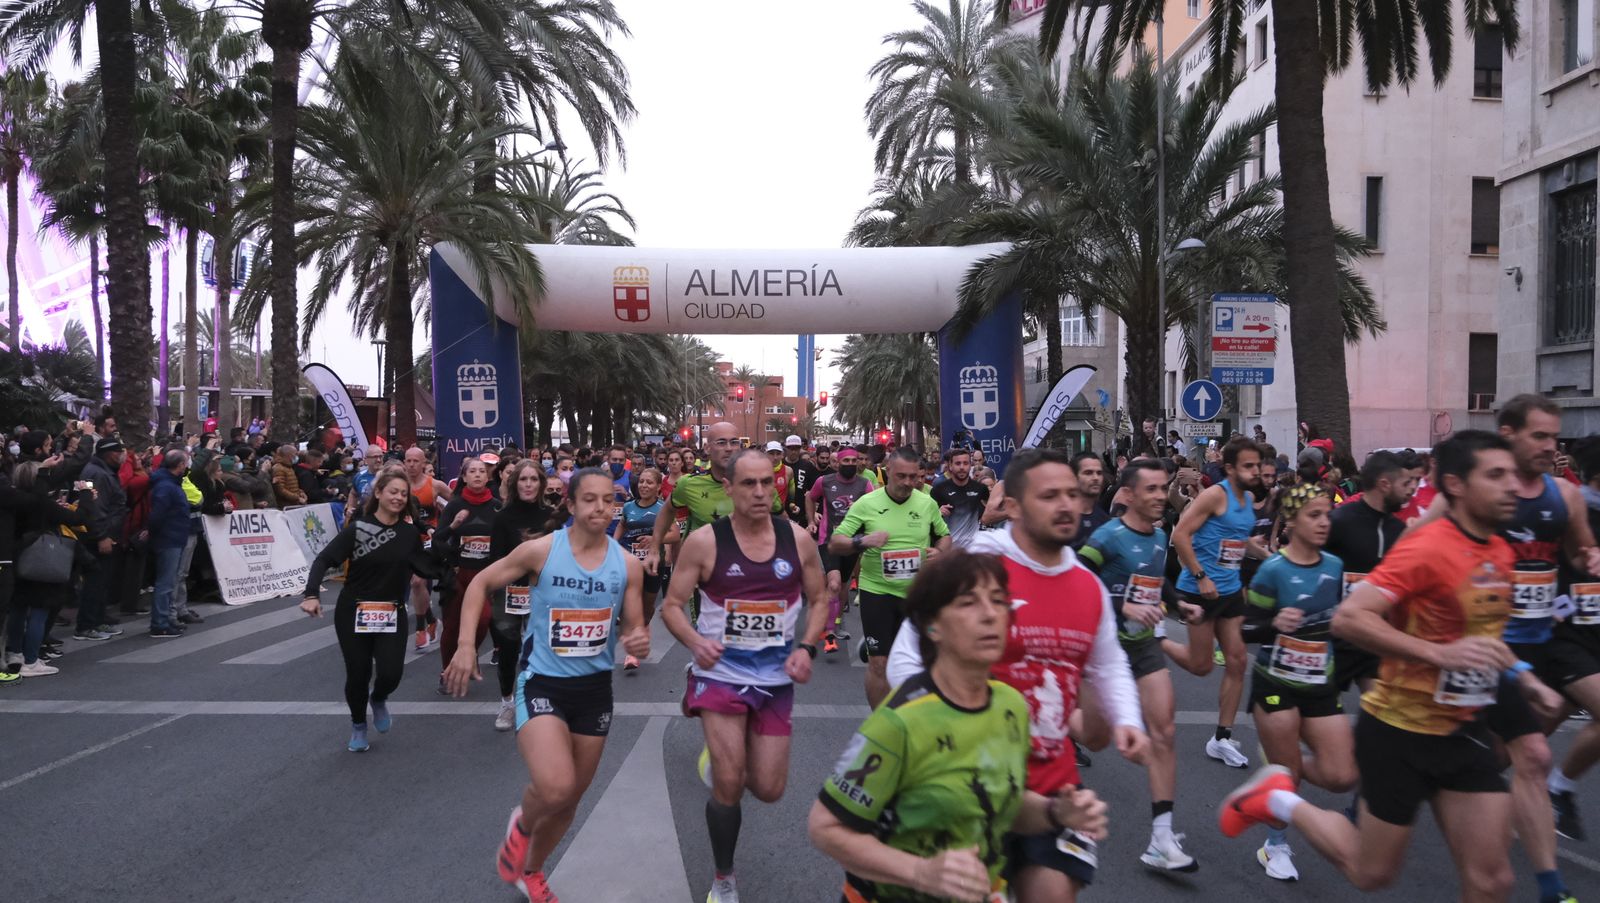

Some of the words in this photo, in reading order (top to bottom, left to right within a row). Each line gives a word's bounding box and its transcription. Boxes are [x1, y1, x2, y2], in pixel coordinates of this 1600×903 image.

[684, 263, 843, 297] ALMERÍA
[684, 302, 765, 319] CIUDAD
[1217, 308, 1232, 325] P
[950, 435, 1016, 453] AERÍA
[797, 469, 806, 489] LDN
[229, 513, 271, 534] AMSA
[890, 558, 913, 570] 211
[224, 575, 258, 588] Transportes
[551, 575, 607, 595] nerja
[228, 585, 257, 599] ANTONIO
[363, 611, 391, 621] 3361
[736, 614, 776, 630] 328
[561, 624, 604, 639] 3473
